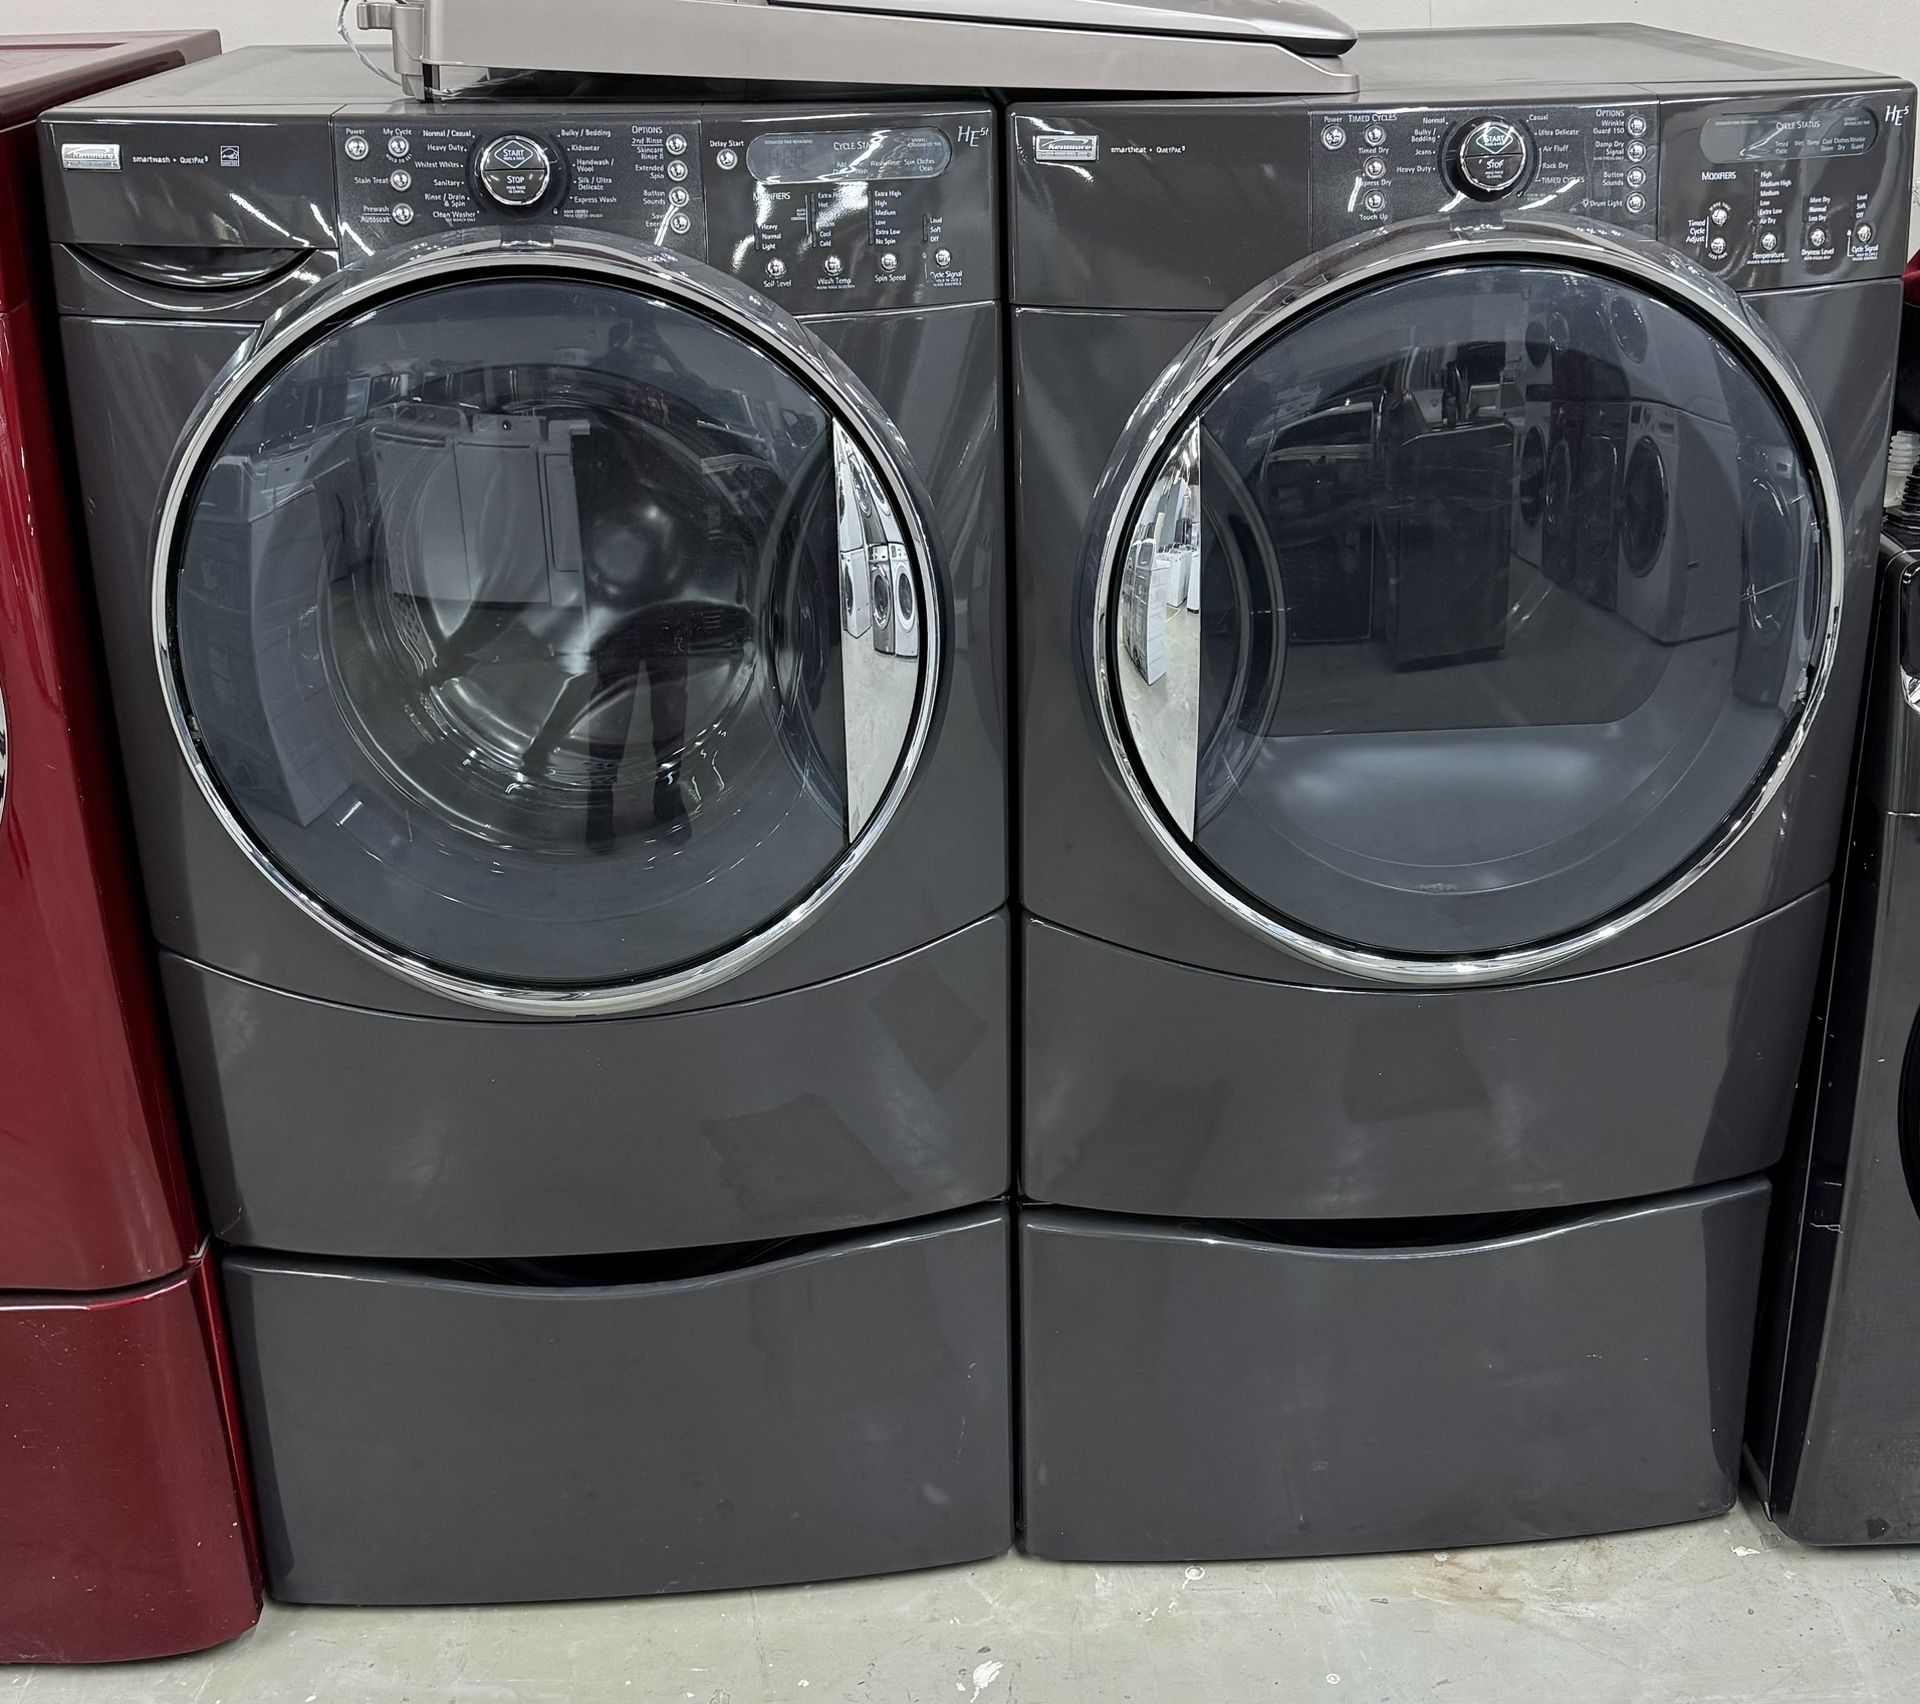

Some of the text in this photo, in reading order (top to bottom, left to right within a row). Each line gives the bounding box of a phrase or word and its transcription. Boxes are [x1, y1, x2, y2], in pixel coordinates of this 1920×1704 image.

[1596, 109, 1625, 117] OPTIONS
[1348, 113, 1398, 123] TIMED CYCLES
[1422, 116, 1445, 124] Normal
[1601, 119, 1625, 127] Wrinkle
[1796, 120, 1821, 129] STATUS
[383, 128, 412, 136] My Cycle
[422, 129, 471, 137] Normal Casual
[561, 129, 611, 137] Bulky Bedding
[1411, 135, 1436, 143] Bedding
[427, 144, 464, 152] Heavy Duty
[709, 140, 728, 148] Delay
[1553, 144, 1569, 152] Fluff
[1595, 140, 1625, 148] Damp Dry
[1837, 144, 1846, 152] Dry
[503, 149, 525, 157] START
[1110, 146, 1147, 154] smartheat
[1378, 146, 1390, 155] Dry
[1415, 148, 1432, 156] Jeans
[1606, 147, 1625, 156] Signal
[132, 156, 171, 164] smartwash
[635, 164, 664, 172] Extended
[1486, 160, 1503, 169] STOP
[1558, 162, 1569, 170] Dry
[1396, 165, 1432, 174] Heavy Duty
[650, 172, 665, 180] Spin
[1760, 171, 1773, 179] High
[433, 179, 460, 187] Sanitary
[506, 175, 525, 184] STOP
[1381, 178, 1392, 187] Dry
[1541, 176, 1561, 184] TIMED
[1780, 179, 1792, 187] High
[643, 189, 665, 197] Button
[889, 190, 902, 198] High
[451, 200, 466, 208] Spin
[574, 196, 598, 204] Express
[1607, 199, 1623, 208] Light
[1822, 196, 1831, 204] Dry
[1856, 202, 1866, 210] Soft
[1360, 213, 1389, 221] Touch Up
[1818, 214, 1827, 222] Dry
[1855, 211, 1864, 219] Off
[929, 216, 943, 224] Loud
[1687, 219, 1706, 227] Timed
[1767, 217, 1776, 225] Dry
[1689, 227, 1705, 236] Cycle
[884, 238, 896, 246] Spin
[1685, 235, 1705, 244] Adjust
[761, 243, 776, 251] Light
[1851, 244, 1879, 254] Cycle Signal
[1752, 252, 1785, 260] Temperature
[874, 274, 906, 283] Spin Speed
[945, 270, 963, 279] Signal
[763, 279, 792, 288] Soil Level
[817, 277, 852, 286] Wash Temp
